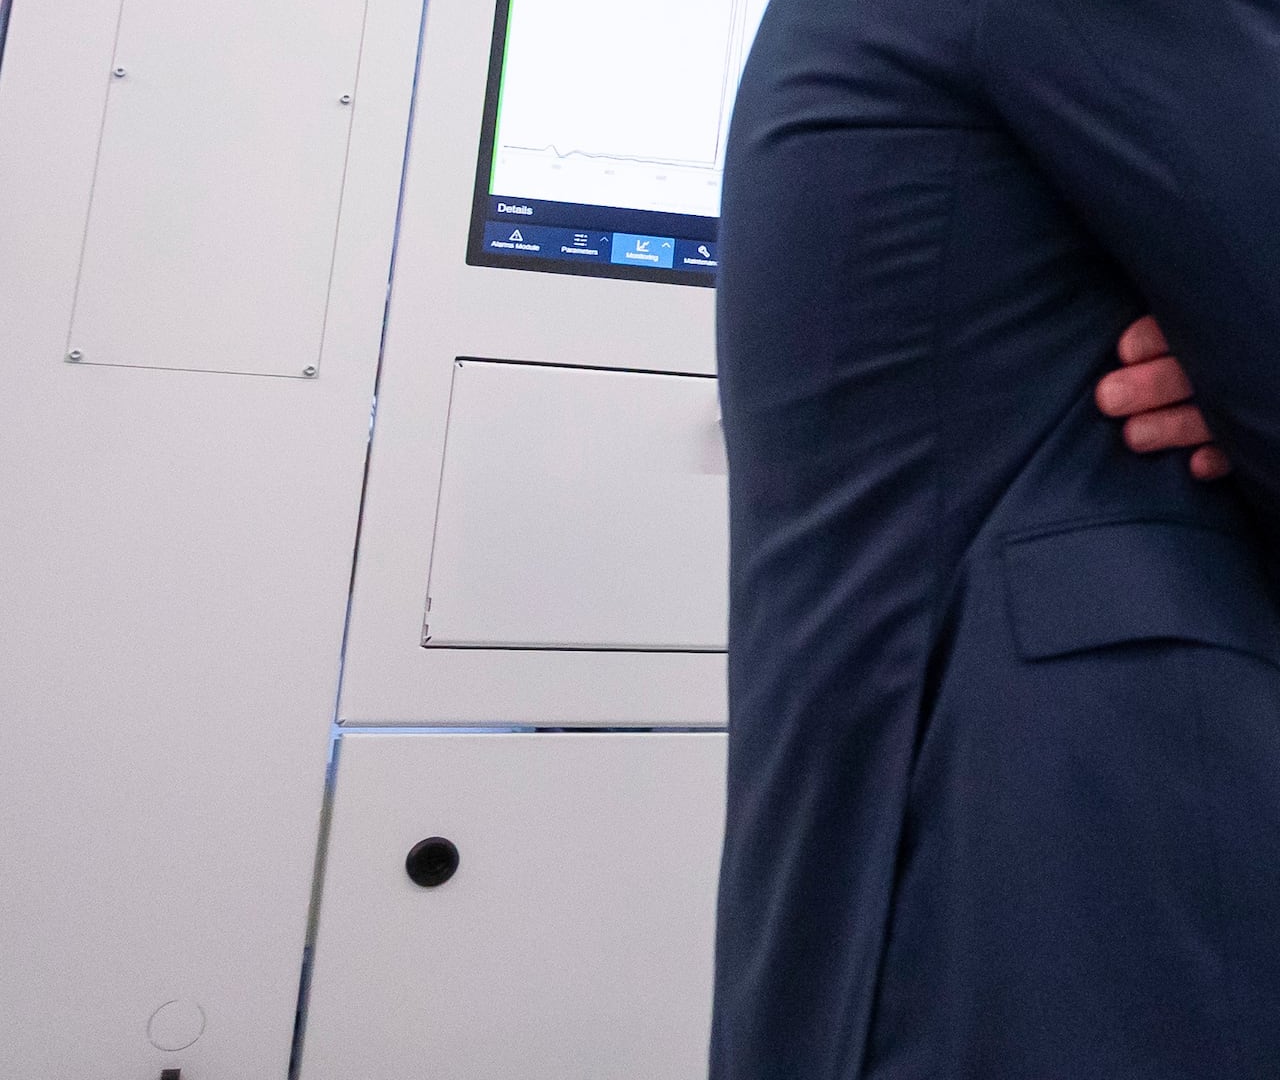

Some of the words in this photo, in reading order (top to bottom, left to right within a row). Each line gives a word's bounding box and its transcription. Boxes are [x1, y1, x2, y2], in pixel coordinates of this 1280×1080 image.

[497, 202, 534, 216] Details
[491, 240, 515, 250] Alarms
[515, 242, 540, 252] Module
[561, 245, 599, 256] Parameters
